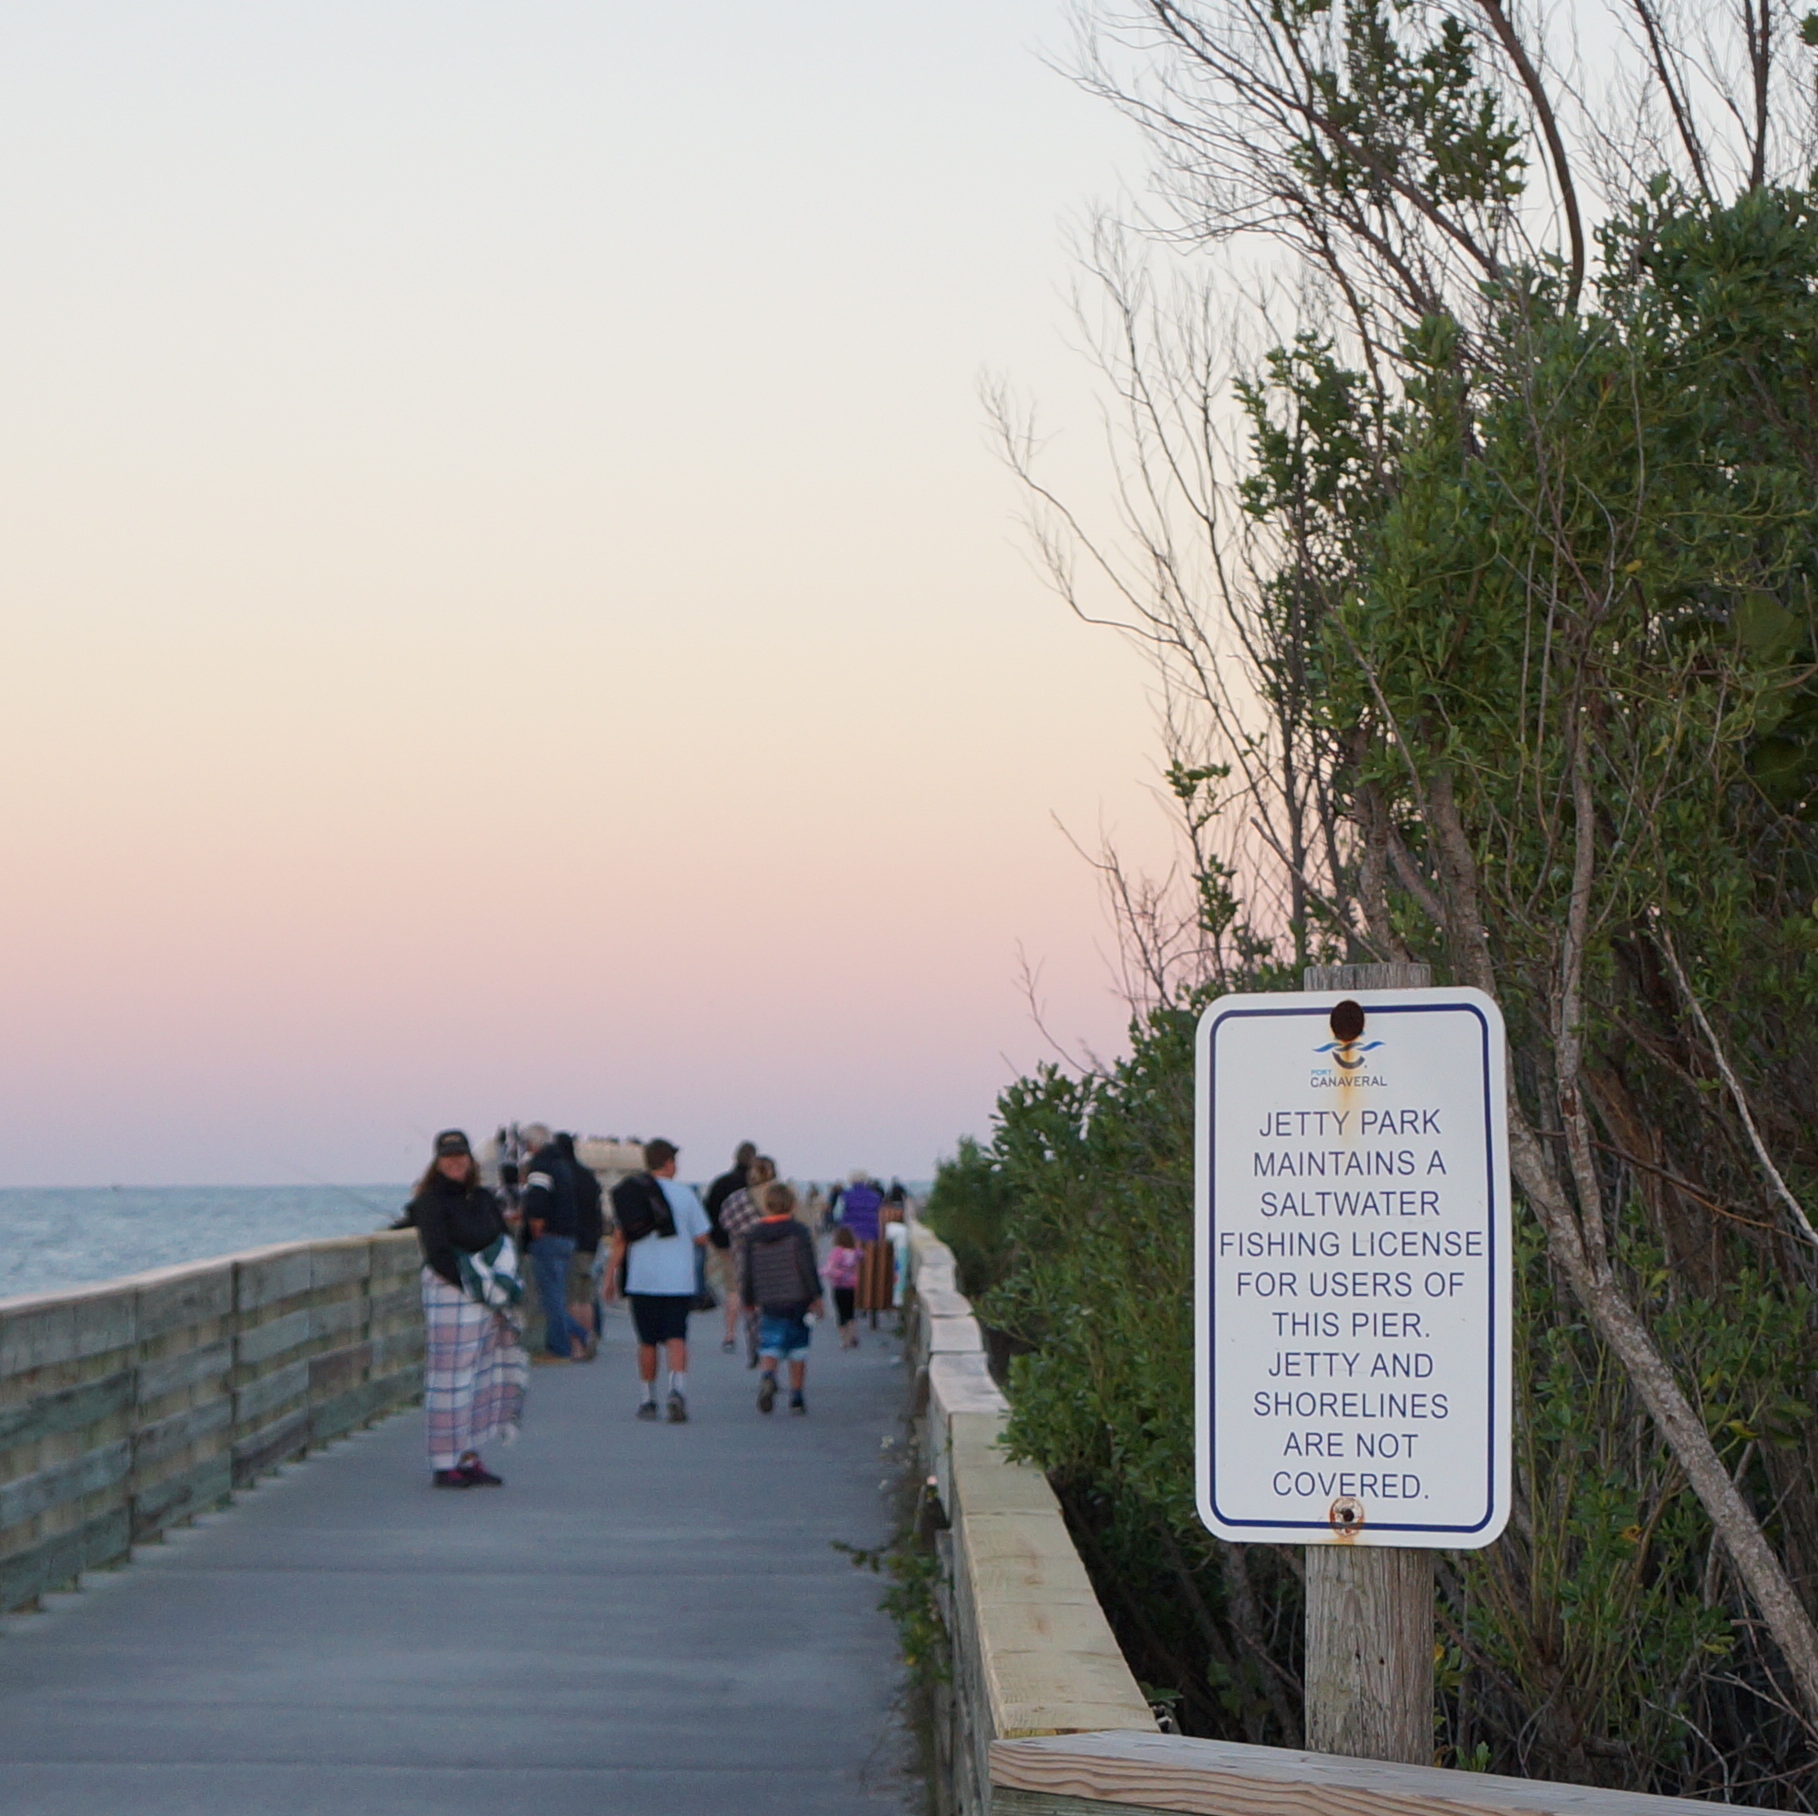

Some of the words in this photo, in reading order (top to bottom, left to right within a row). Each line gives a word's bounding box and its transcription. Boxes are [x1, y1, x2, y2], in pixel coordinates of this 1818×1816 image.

[1310, 1075, 1388, 1088] CANAVERAL
[1260, 1111, 1350, 1136] JETTY
[1362, 1109, 1441, 1135] PARK
[1255, 1150, 1415, 1176] MAINTAINS
[1427, 1150, 1446, 1175] A
[1261, 1191, 1440, 1217] SALTWATER
[1219, 1231, 1340, 1258] FISHING
[1353, 1230, 1484, 1258] LICENSE
[1238, 1272, 1297, 1297] FOR
[1310, 1272, 1412, 1297] USERS
[1425, 1272, 1464, 1297] OF
[1272, 1312, 1339, 1337] THIS
[1353, 1313, 1429, 1337] PIER.
[1269, 1352, 1360, 1377] JETTY
[1370, 1353, 1433, 1378] AND
[1254, 1392, 1448, 1419] SHORELINES
[1284, 1432, 1344, 1457] ARE
[1357, 1433, 1418, 1458] NOT
[1273, 1471, 1429, 1499] COVERED.
